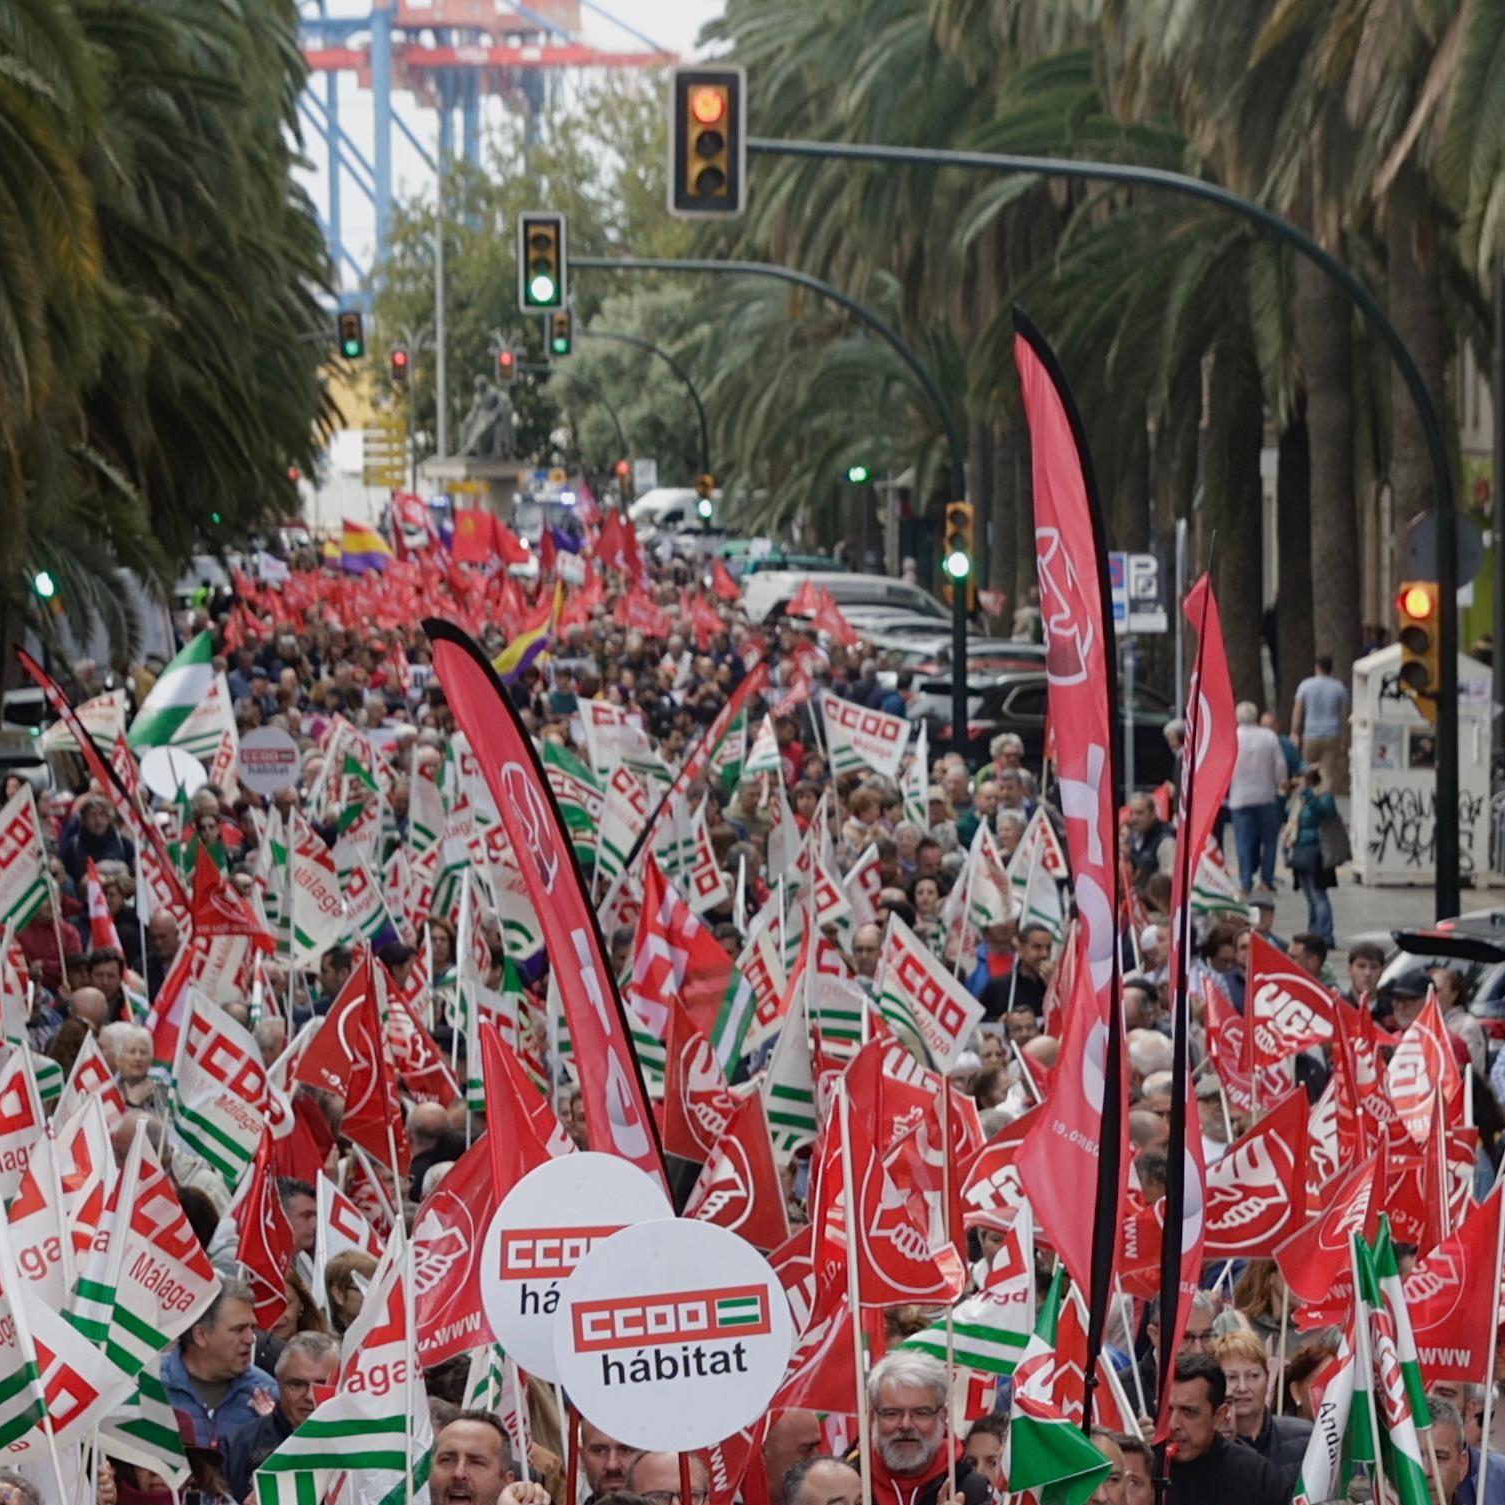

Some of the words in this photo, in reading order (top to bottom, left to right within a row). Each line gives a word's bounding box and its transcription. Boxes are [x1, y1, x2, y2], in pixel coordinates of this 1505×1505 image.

[1253, 982, 1334, 1039] UGT
[128, 1250, 197, 1313] Málaga
[582, 1300, 709, 1342] CCOO
[601, 1342, 749, 1387] hábitat
